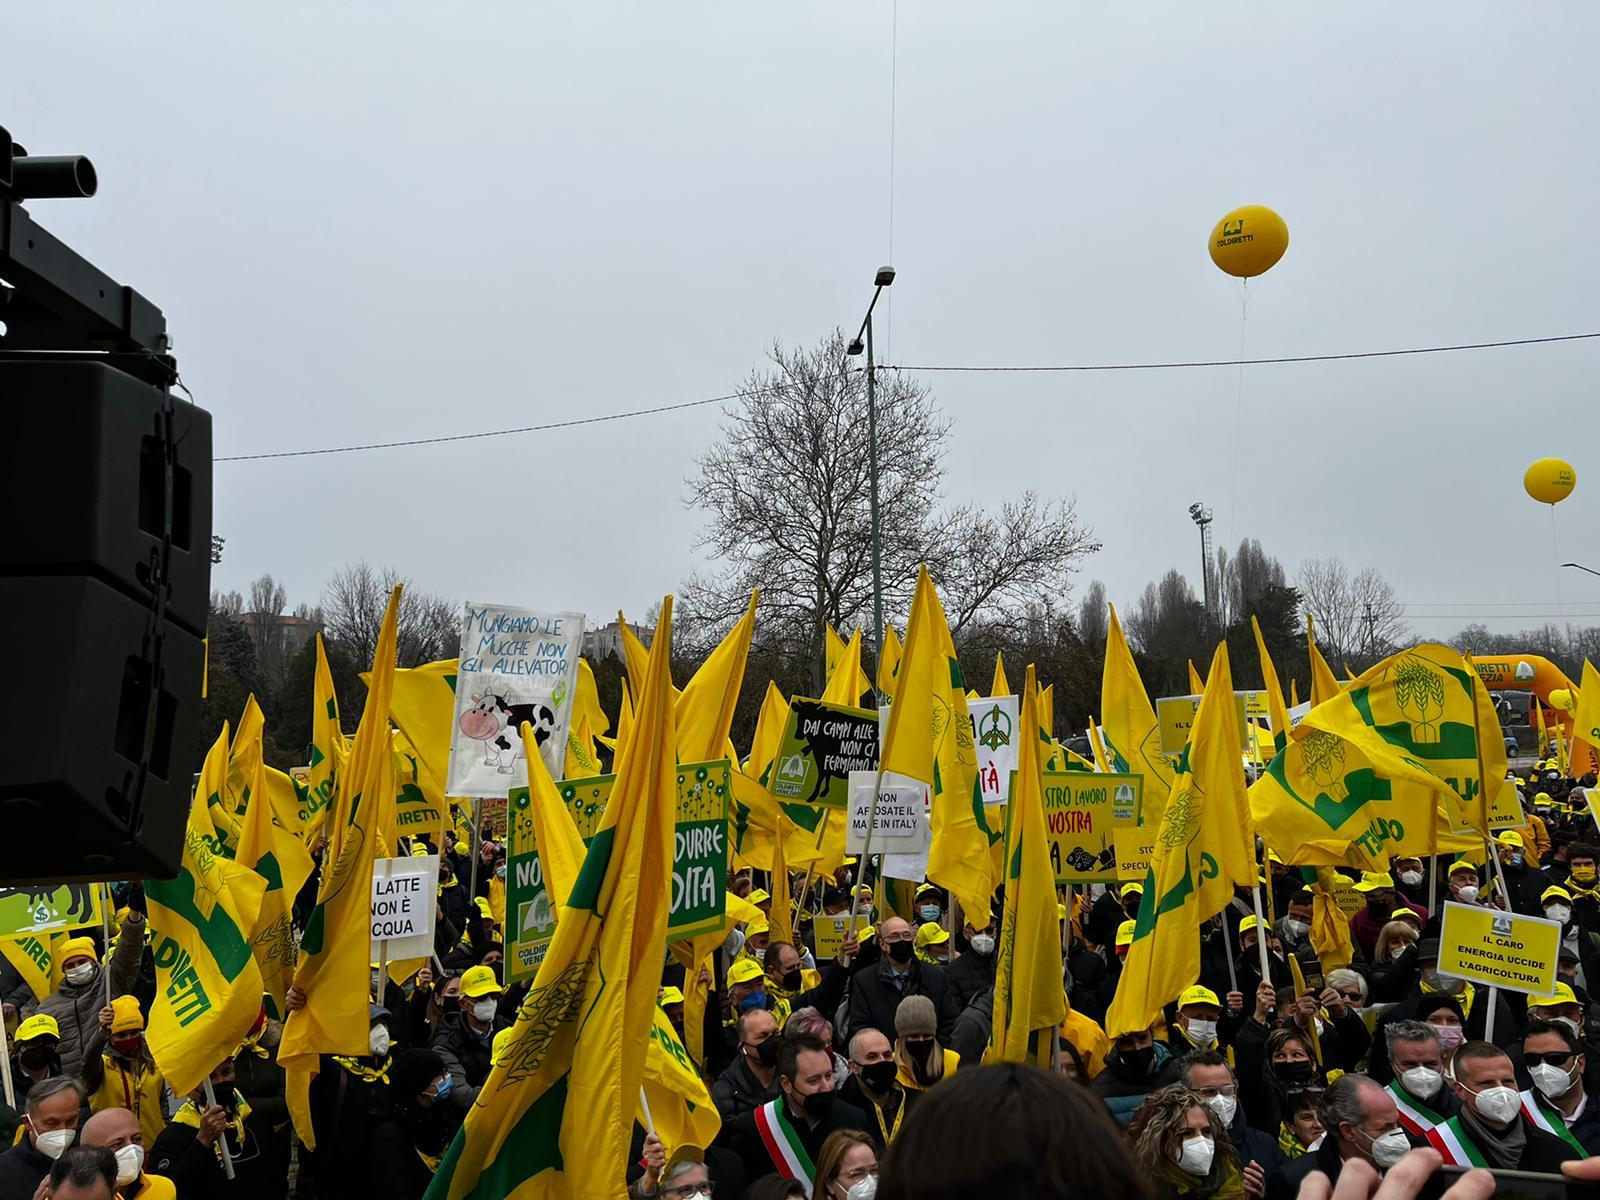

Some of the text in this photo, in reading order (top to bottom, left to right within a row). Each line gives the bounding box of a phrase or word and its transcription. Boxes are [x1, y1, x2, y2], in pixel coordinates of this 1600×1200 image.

[1216, 234, 1254, 248] COLDIRETTI
[466, 608, 563, 647] MUNGIAMO LE
[476, 633, 567, 658] MUCCHE NON
[461, 657, 484, 673] GLI
[802, 719, 821, 736] DAI
[823, 721, 852, 740] CAMPI
[853, 724, 874, 741] ALLE
[839, 740, 876, 758] NON CI
[823, 754, 871, 774] FERMIAMO
[1045, 785, 1108, 809] STRO LAVORO
[856, 805, 915, 817] AFOSATE IL
[852, 818, 918, 830] MAE IN ITALY
[1047, 809, 1093, 835] VOSTRA
[673, 824, 724, 865] DURRE
[515, 857, 545, 889] NO
[376, 877, 421, 896] LATTE
[401, 895, 411, 914] È
[371, 919, 414, 937] CQUA
[1483, 935, 1524, 951] IL CARO
[1457, 944, 1546, 971] ENERGIA UCCIDE
[1458, 960, 1541, 985] L'AGRICOLTURA
